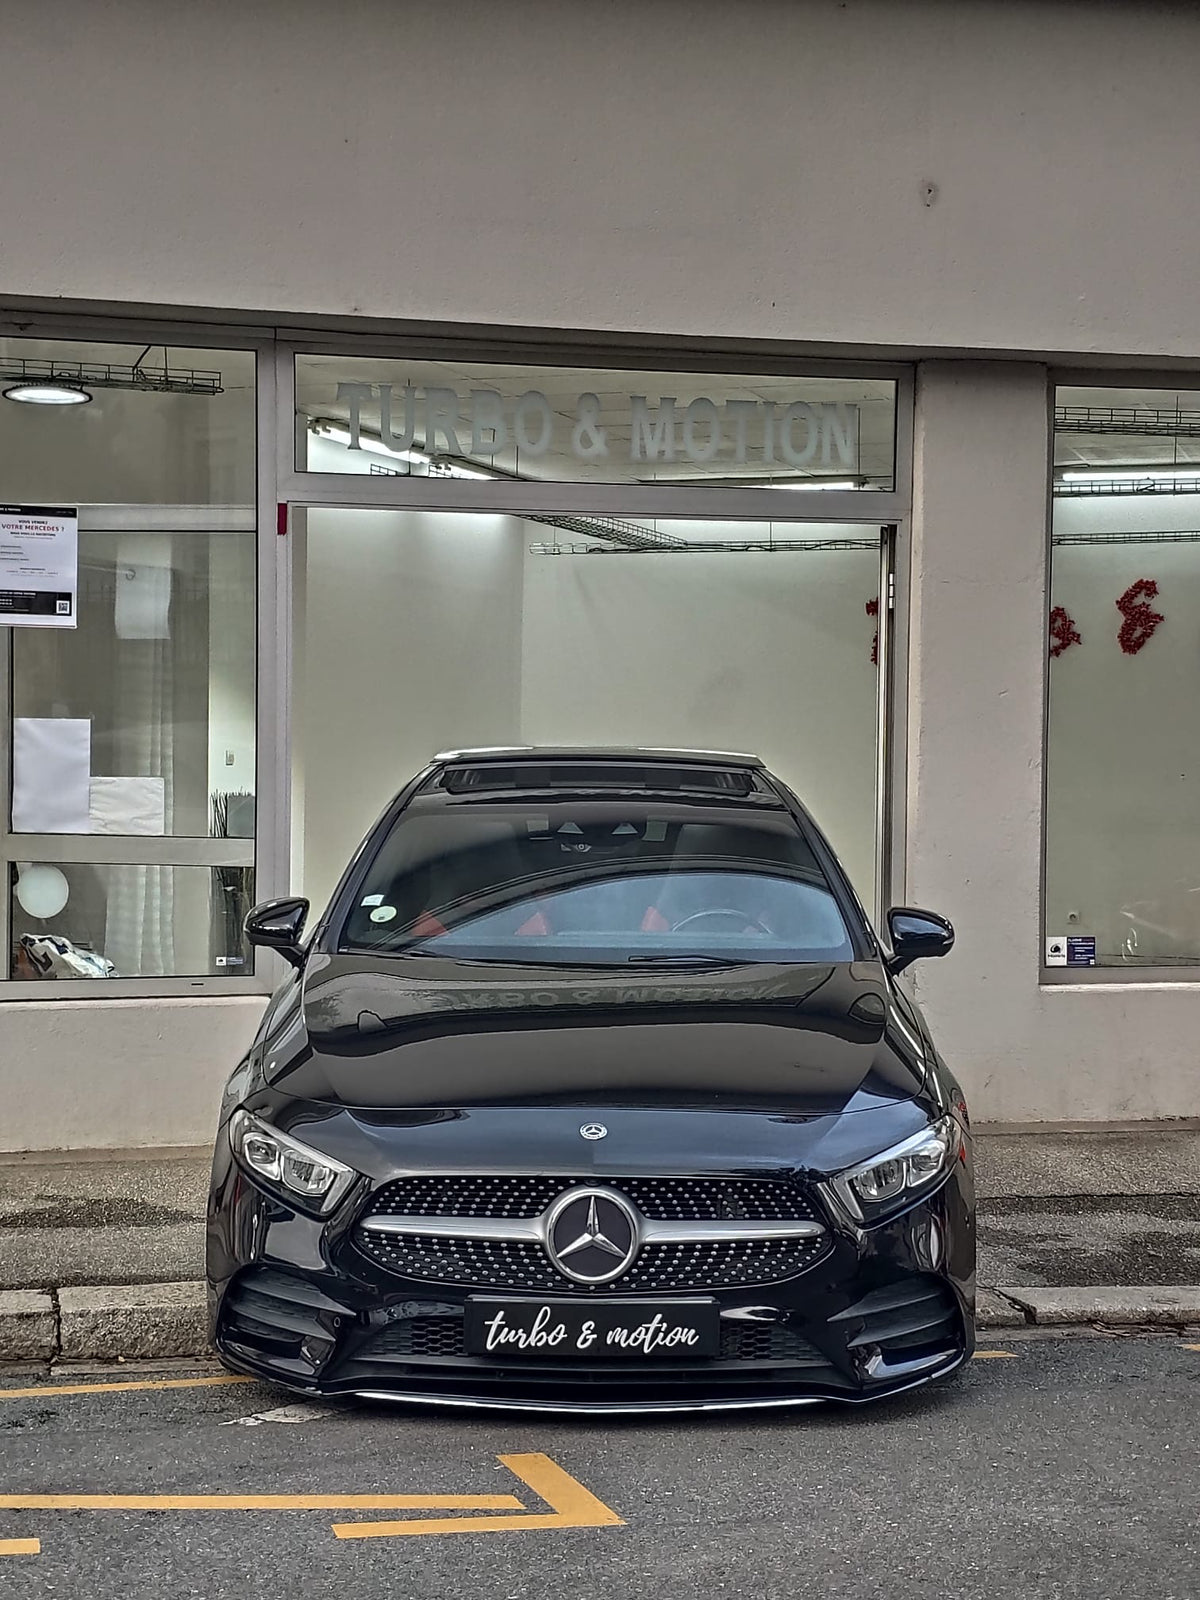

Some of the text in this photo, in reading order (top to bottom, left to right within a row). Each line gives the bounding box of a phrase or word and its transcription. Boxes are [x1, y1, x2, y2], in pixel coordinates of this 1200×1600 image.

[336, 382, 858, 465] TURBO & MOTION
[25, 524, 60, 532] MERCEDES
[484, 1305, 700, 1354] turbo & motion
